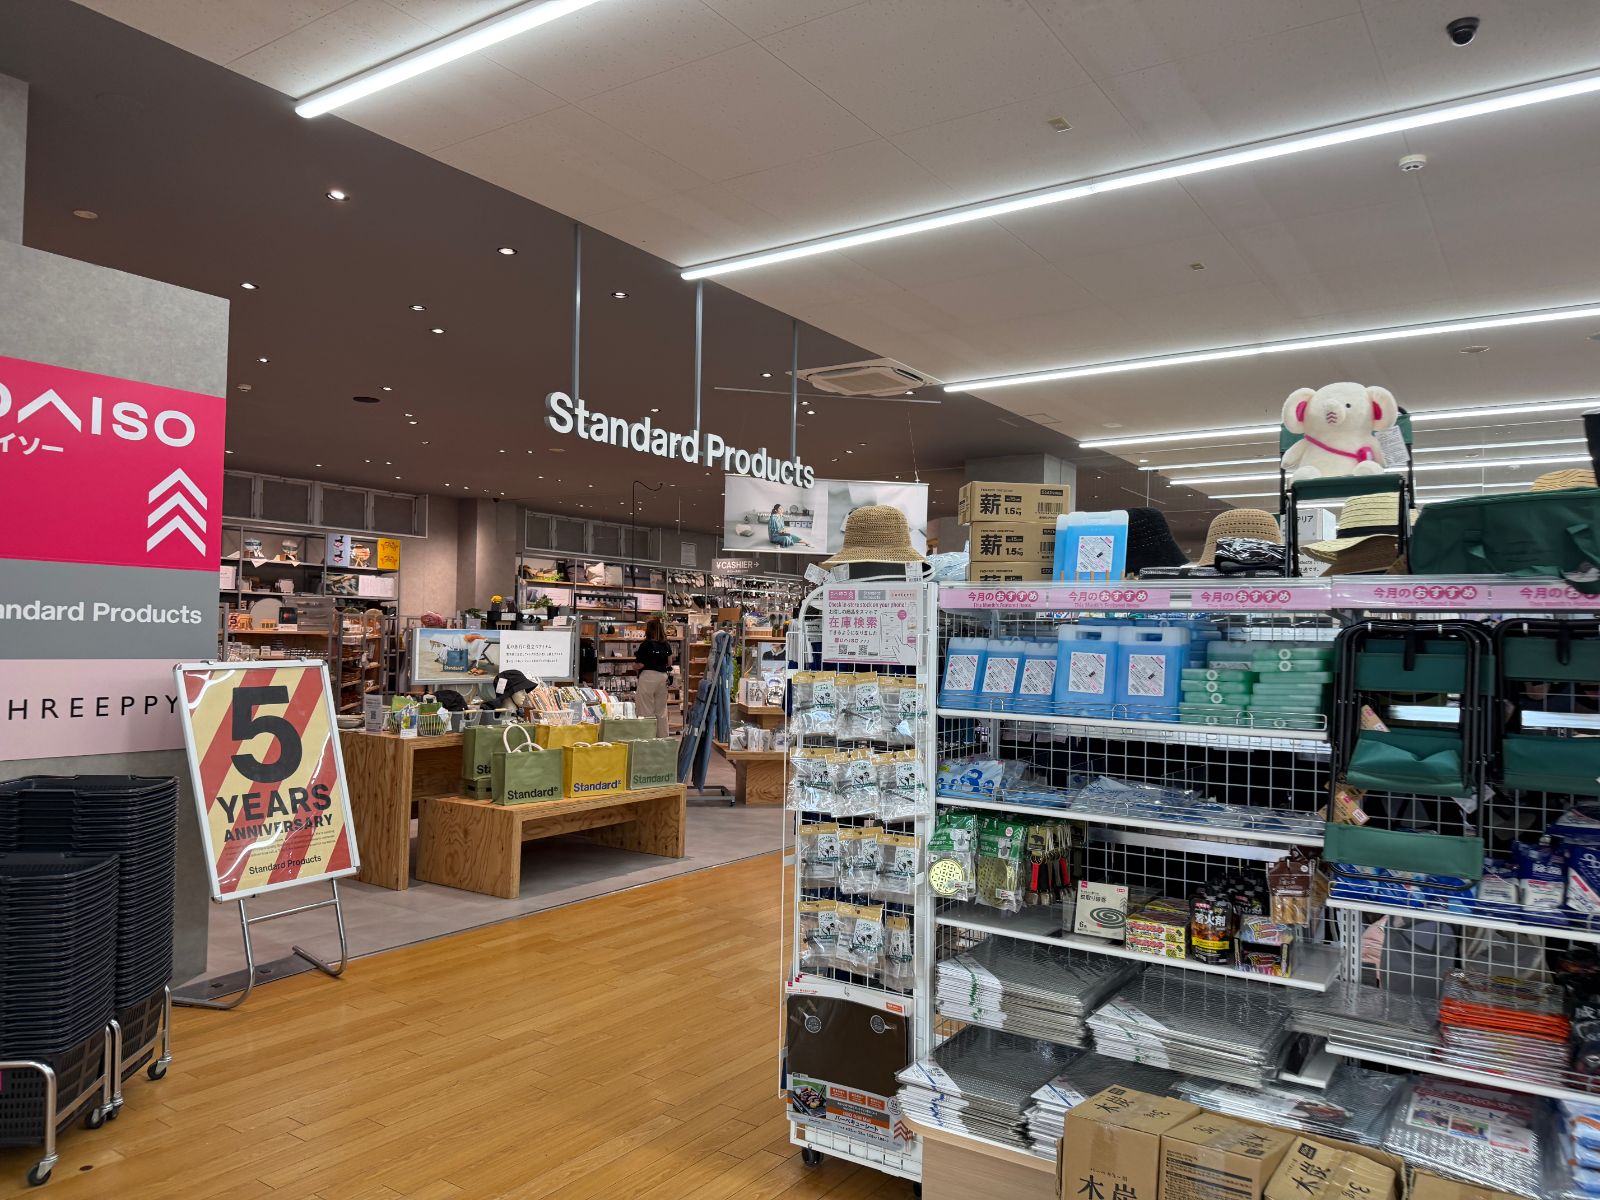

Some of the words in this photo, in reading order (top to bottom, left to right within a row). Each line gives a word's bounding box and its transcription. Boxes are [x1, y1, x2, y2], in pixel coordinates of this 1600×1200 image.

[545, 391, 699, 464] Standard
[703, 433, 815, 489] Products
[980, 493, 1001, 515] 薪
[980, 534, 1002, 556] 薪
[968, 590, 1039, 602] 今月のおすすめ
[1068, 589, 1148, 602] 今月のおすすめ
[1200, 589, 1292, 603] 今月のおすすめ
[1373, 585, 1477, 600] 今月のおすすめ
[1519, 586, 1599, 600] 今月のお
[93, 602, 202, 625] Products
[828, 616, 878, 629] 在庫検索
[230, 685, 303, 784] 5
[216, 783, 332, 824] YEARS
[224, 813, 333, 843] ANNIVERSARY
[249, 861, 286, 875] Standard
[287, 854, 322, 868] Products
